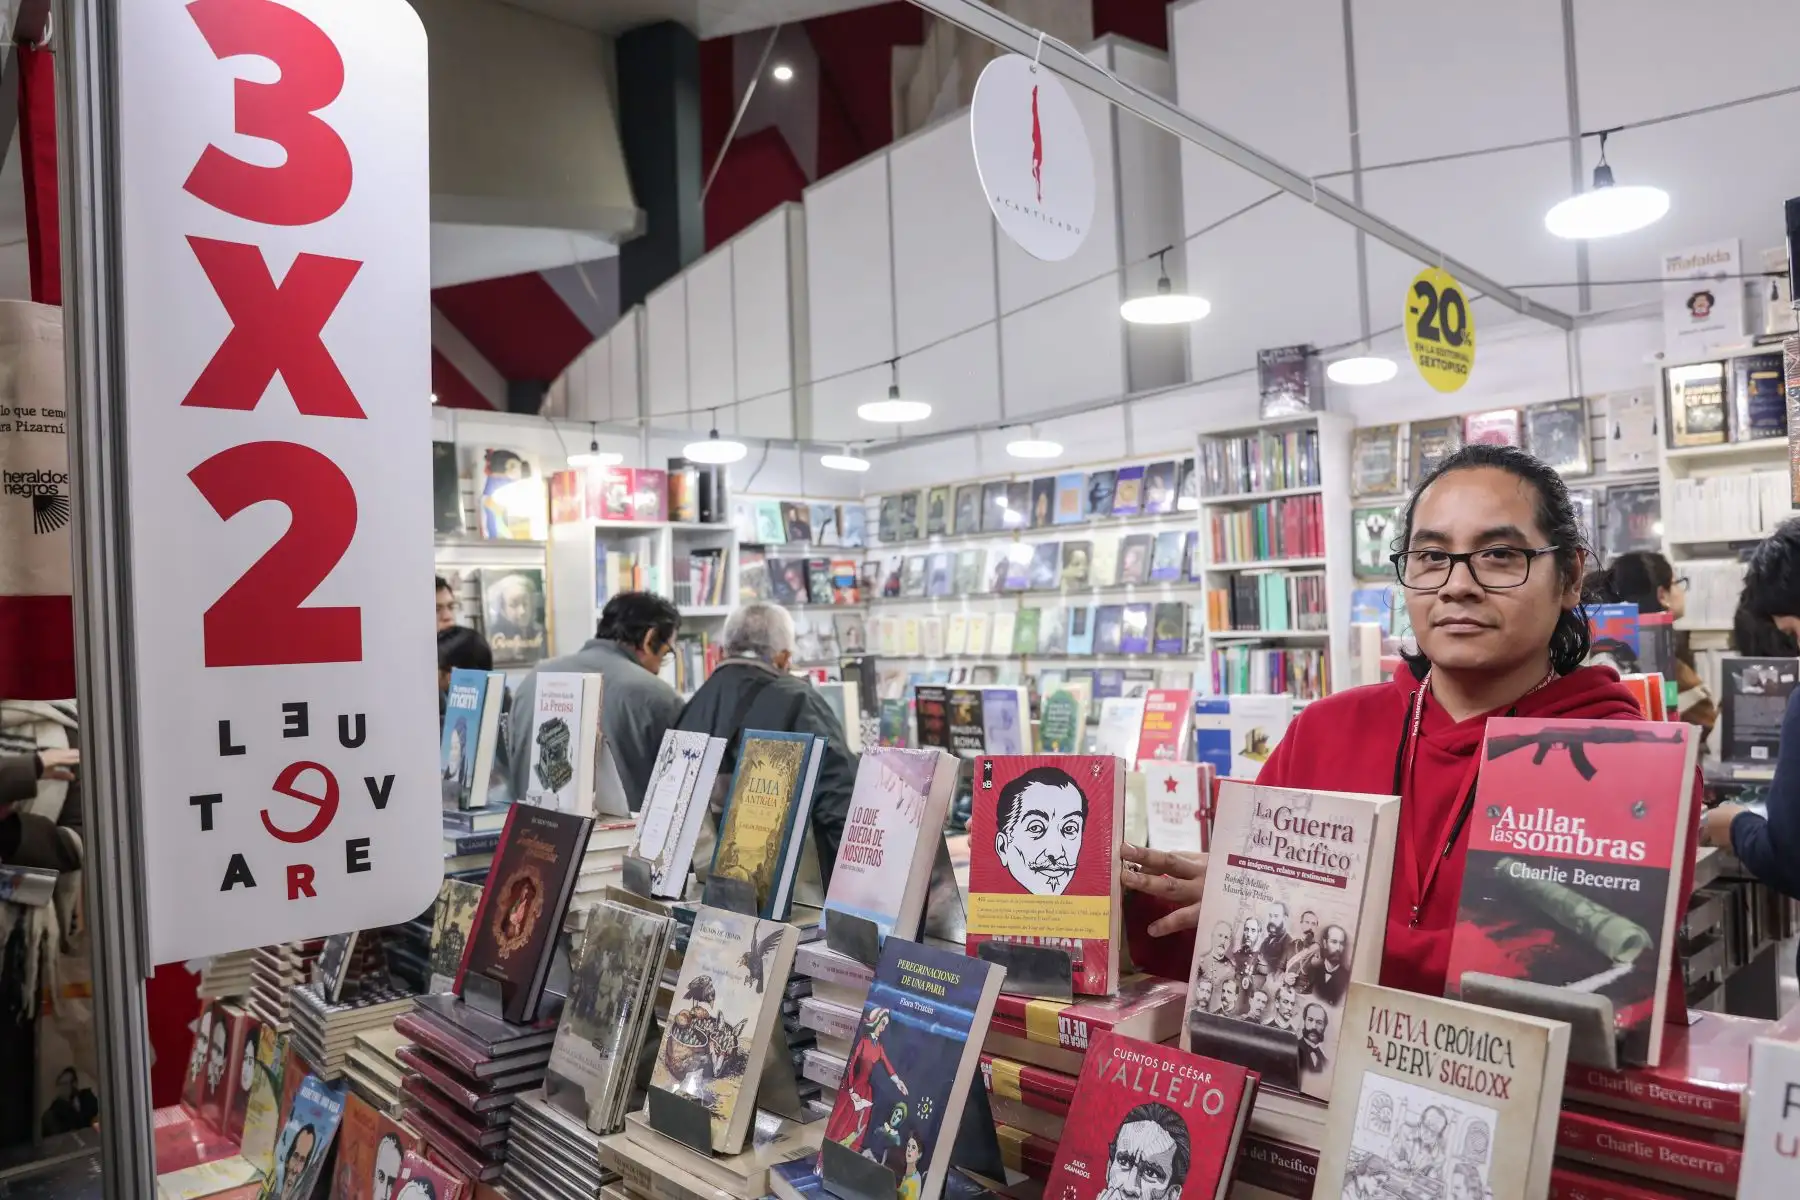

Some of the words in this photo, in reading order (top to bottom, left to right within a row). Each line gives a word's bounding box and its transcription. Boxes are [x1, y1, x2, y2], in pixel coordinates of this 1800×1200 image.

[997, 196, 1081, 235] ACANTILADO
[1420, 355, 1468, 375] SEXTOPISO
[14, 407, 36, 418] que
[3, 469, 68, 484] heraldos
[4, 483, 59, 498] negros
[540, 700, 549, 712] La
[550, 699, 574, 713] Prensa
[749, 777, 779, 796] LIMA
[744, 795, 777, 807] ANTIGUA
[852, 806, 863, 824] LO
[862, 808, 880, 826] QUE
[1256, 802, 1272, 819] La
[1273, 806, 1354, 843] Guerra
[1496, 806, 1585, 834] Aullar
[848, 825, 873, 845] QUEDA
[872, 829, 885, 847] DE
[1490, 825, 1513, 843] las
[1512, 829, 1646, 861] sombras
[843, 844, 883, 867] NOSOTROS
[1253, 829, 1272, 846] del
[1272, 836, 1350, 870] Pacífico
[1276, 866, 1296, 876] relatos
[1301, 871, 1336, 884] testimonios
[1510, 862, 1568, 883] Charlie
[1573, 868, 1641, 892] Becerra
[897, 959, 960, 985] PEREGRINACIONES
[901, 974, 912, 986] DE
[911, 977, 925, 991] UNA
[925, 981, 945, 996] PARIA
[900, 997, 913, 1008] Flora
[1073, 1020, 1087, 1038] DE
[1113, 1047, 1159, 1069] CUENTOS
[1162, 1061, 1175, 1073] DE
[1178, 1064, 1212, 1085] CÉSAR
[1097, 1057, 1225, 1115] VALLEJO
[1588, 1071, 1643, 1096] Charlie
[1649, 1084, 1713, 1110] Becerra
[1072, 1159, 1086, 1169] JULIO
[1249, 1147, 1267, 1162] del
[1270, 1150, 1316, 1176] Pacífico
[1596, 1133, 1653, 1159] Charlie
[1659, 1148, 1724, 1174] Becerra
[1063, 1163, 1091, 1179] GRANADOS
